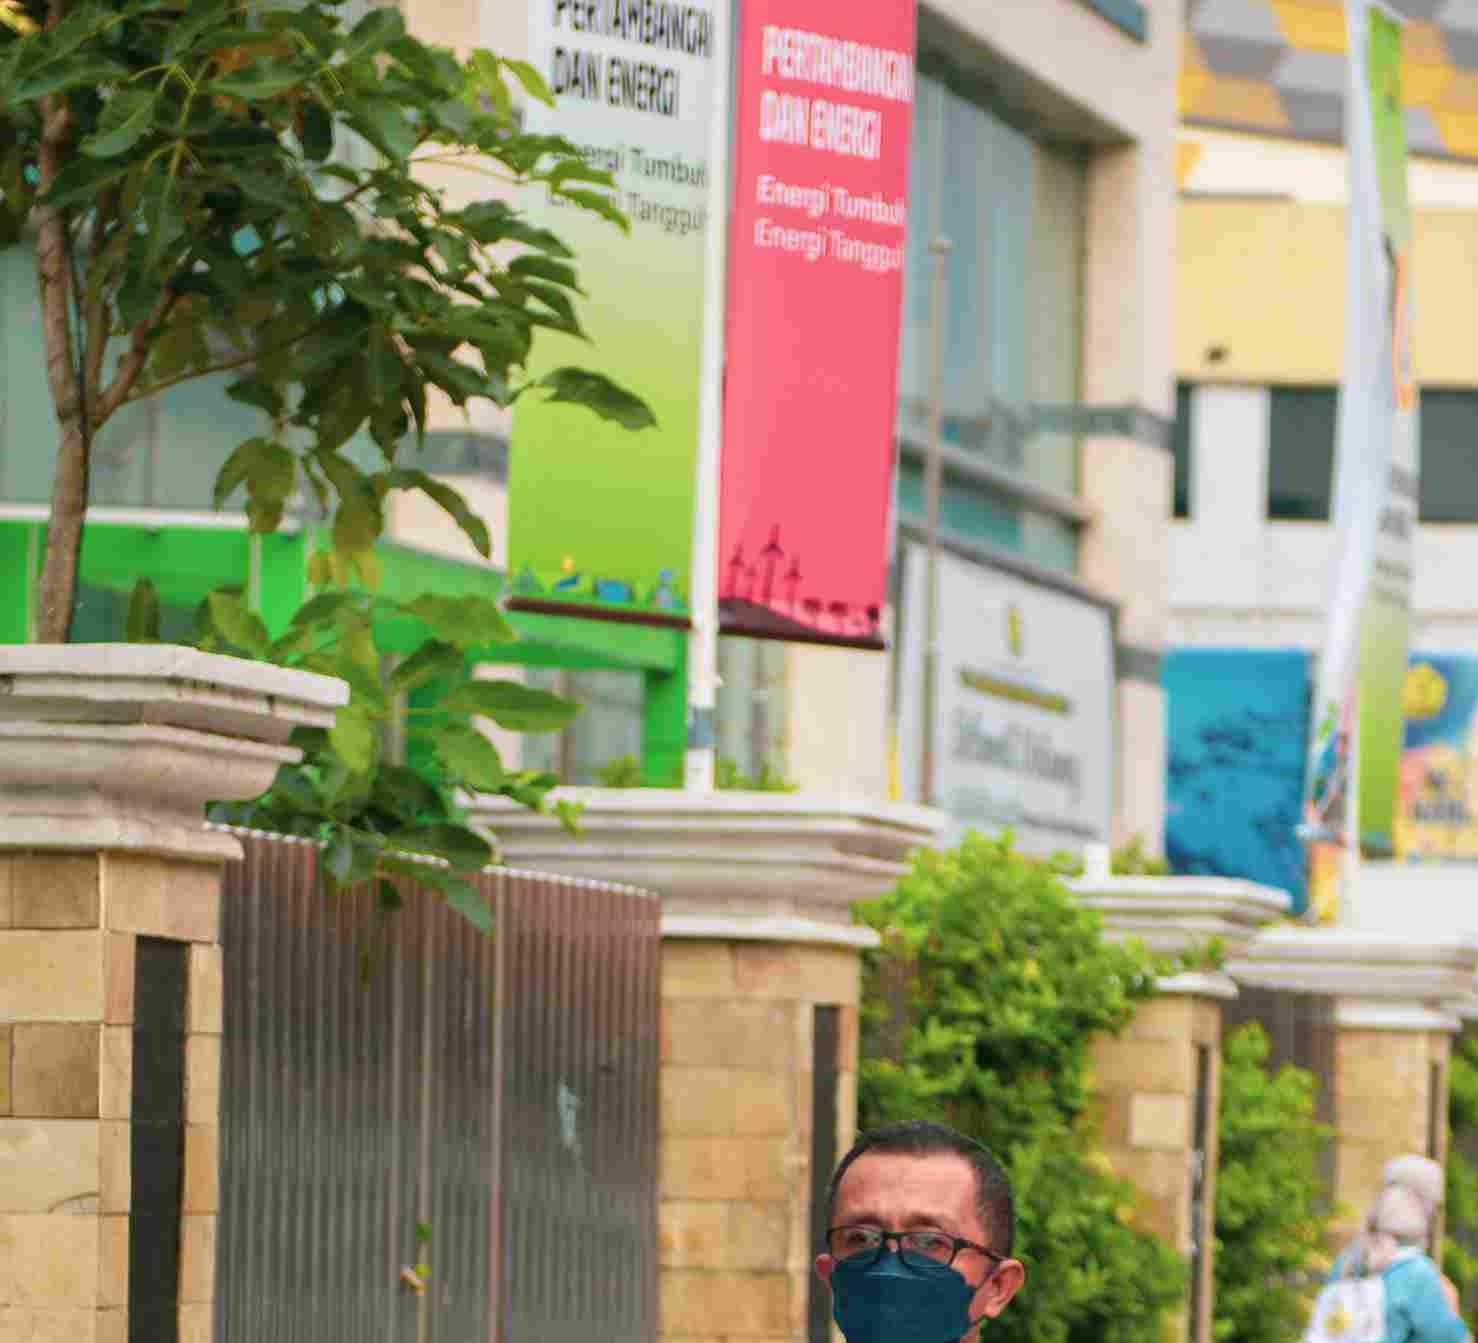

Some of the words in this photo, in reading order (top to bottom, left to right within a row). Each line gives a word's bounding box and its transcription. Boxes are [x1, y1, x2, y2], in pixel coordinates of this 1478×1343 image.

[552, 0, 712, 57] PERTAMBANGA
[552, 47, 601, 99] DAN
[608, 57, 680, 118] ENERGI
[760, 90, 809, 145] DAN
[811, 99, 881, 160] ENERGI
[630, 145, 705, 187] Tumbu
[626, 192, 706, 235] Tanggu
[757, 174, 831, 218] Energi
[753, 217, 827, 263] Energi
[830, 229, 904, 273] Tanggu
